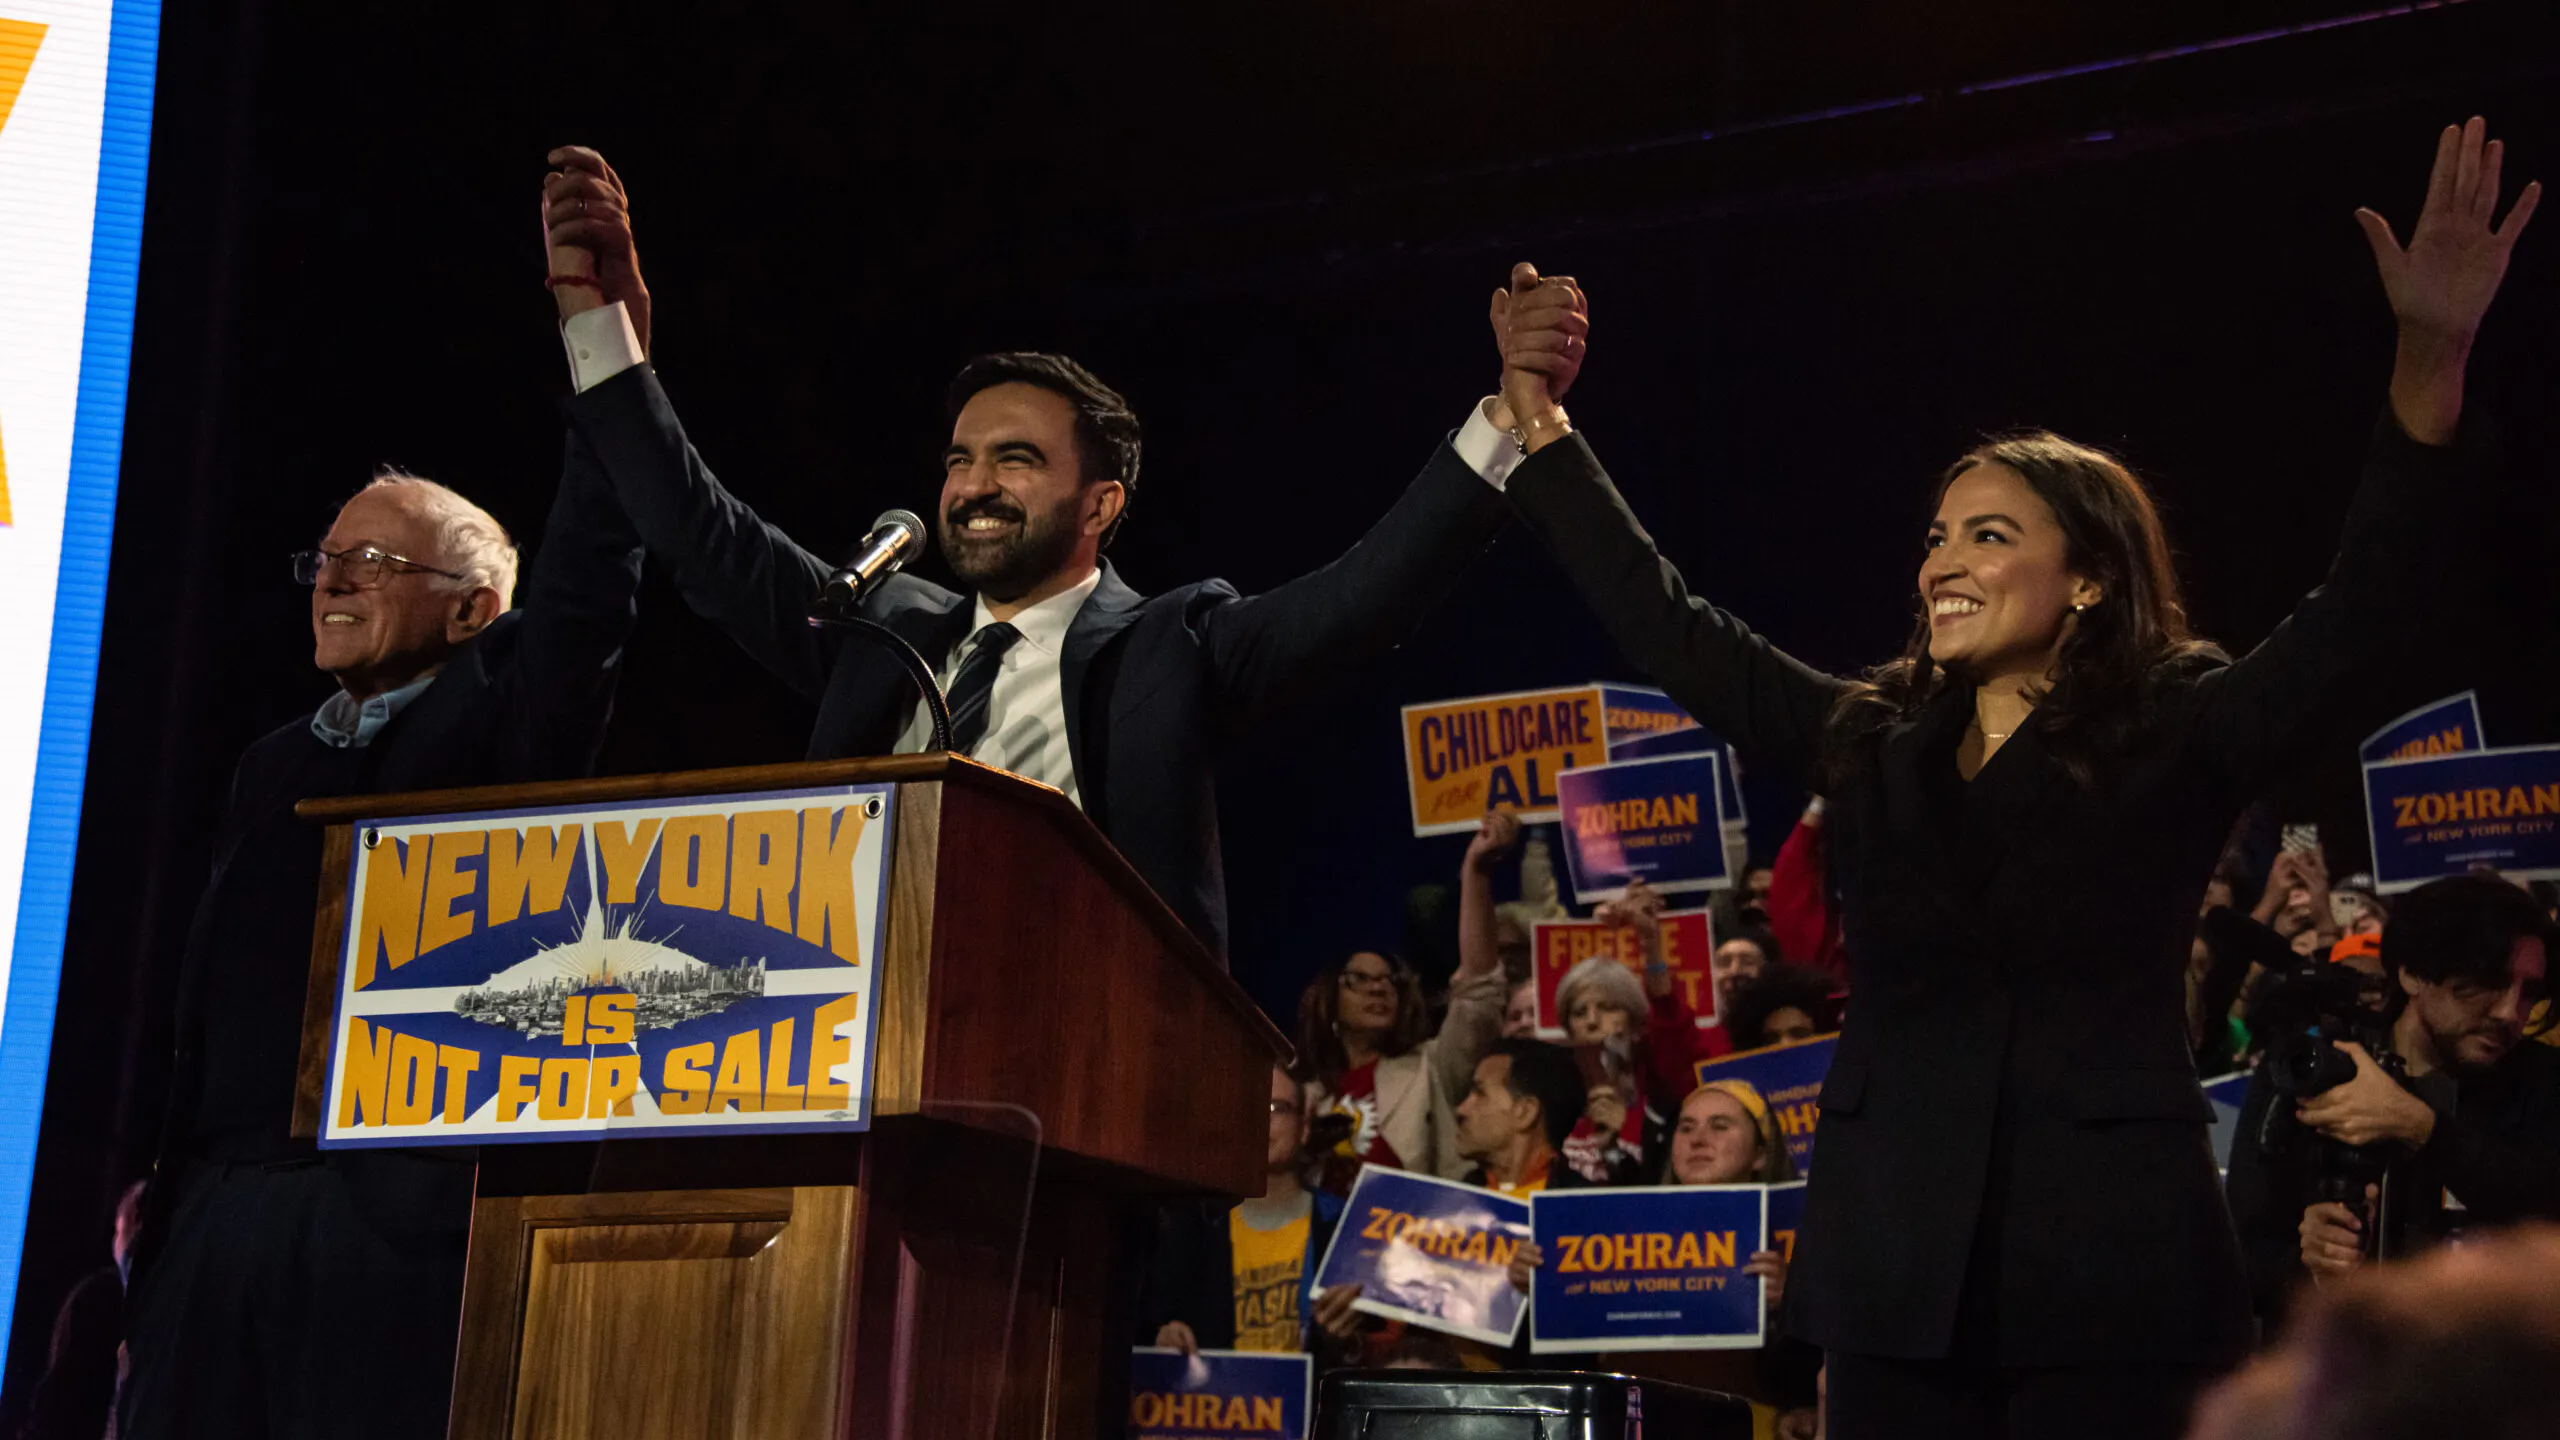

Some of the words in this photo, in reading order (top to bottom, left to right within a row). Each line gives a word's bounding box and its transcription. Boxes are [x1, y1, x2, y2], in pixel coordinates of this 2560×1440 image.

[1420, 699, 1592, 780] CHILDCARE
[1575, 793, 1699, 838] ZOHRAN
[2392, 783, 2560, 828] ZOHRAN
[2426, 828, 2464, 843] NEW
[355, 823, 583, 991] NEW
[593, 804, 867, 966] YORK
[1548, 921, 1682, 970] FREEE
[562, 993, 637, 1047] IS
[337, 1015, 480, 1128] NOT
[496, 1055, 641, 1122] FOR
[660, 992, 858, 1115] SALE
[1361, 1206, 1519, 1266] ZOHRAN
[1556, 1230, 1736, 1273] ZOHRAN
[1589, 1278, 1631, 1294] NEW
[1635, 1277, 1682, 1292] YORK
[1685, 1275, 1727, 1291] CITY
[1132, 1391, 1284, 1432] OHRAN
